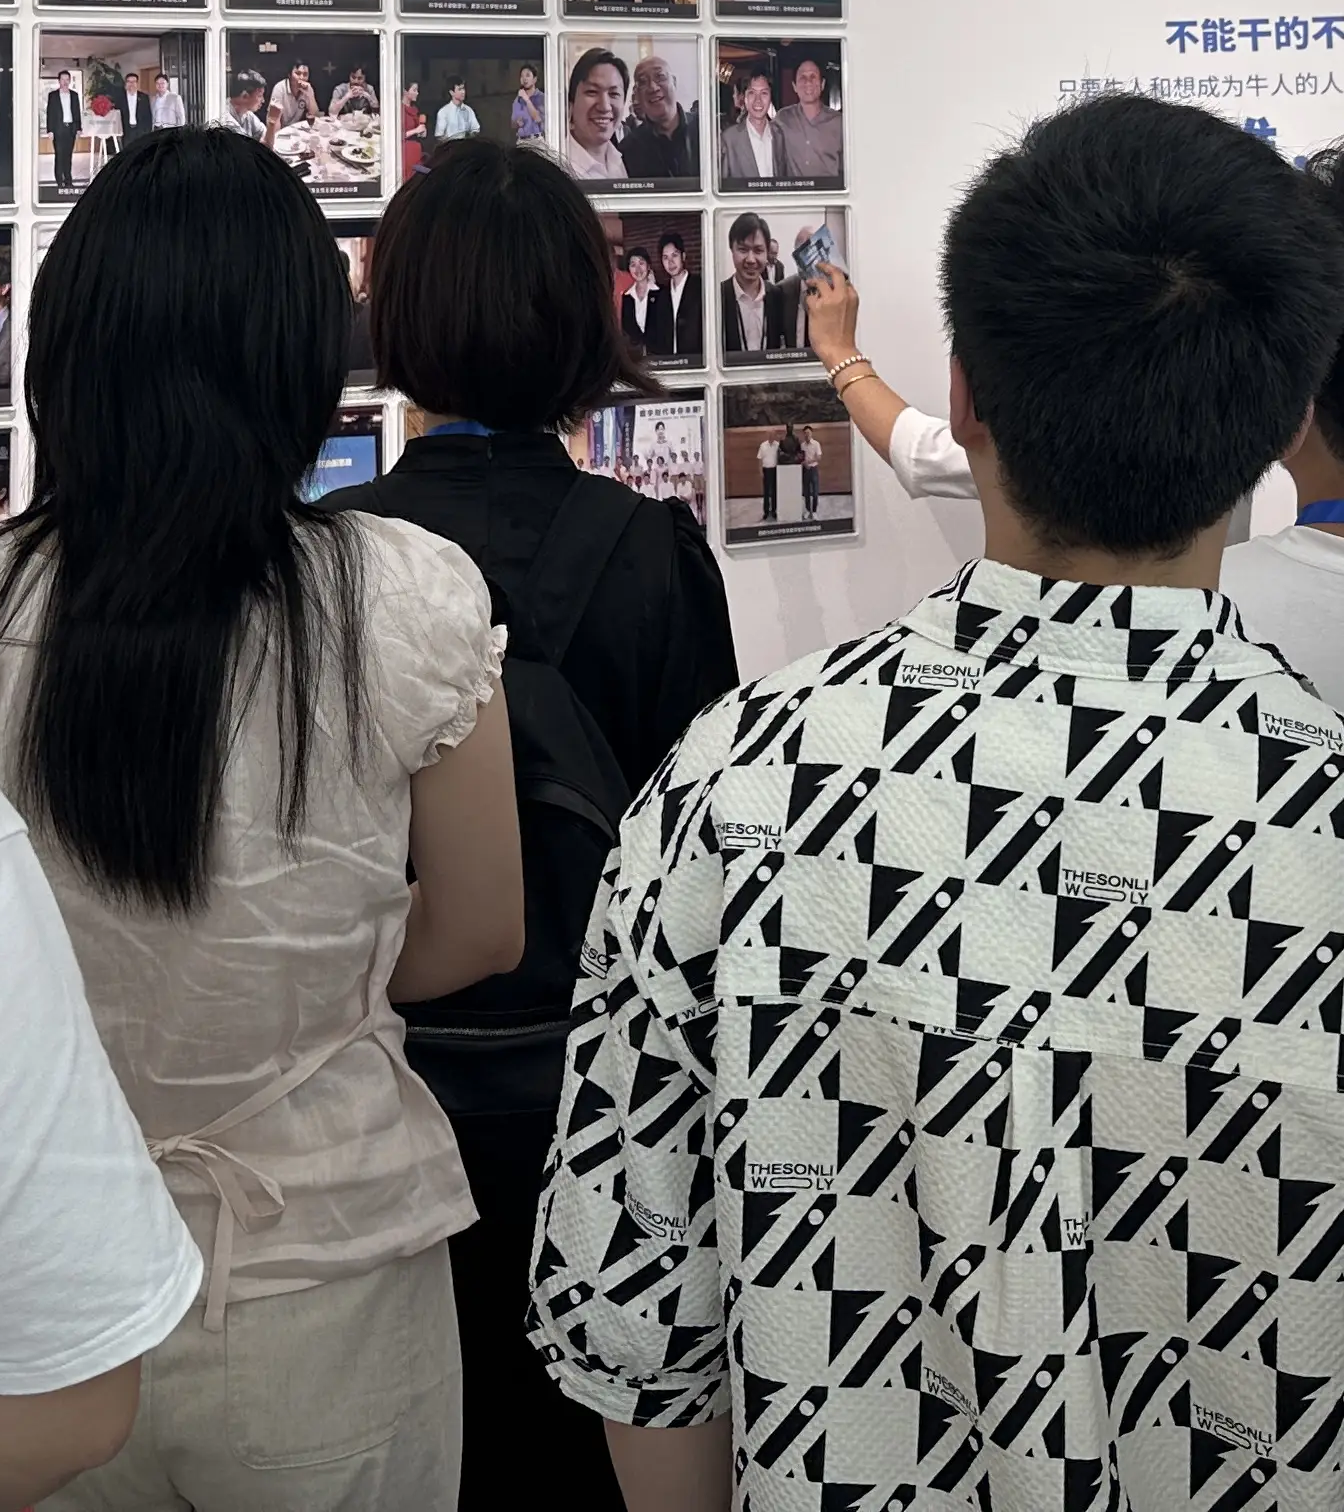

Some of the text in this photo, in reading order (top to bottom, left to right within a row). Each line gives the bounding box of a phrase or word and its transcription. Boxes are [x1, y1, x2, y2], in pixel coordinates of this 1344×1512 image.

[901, 663, 981, 678] THESONLI
[1260, 711, 1343, 742] THESONLI
[1061, 868, 1150, 891] THESONLI
[747, 1163, 834, 1177] THESONLI
[1193, 1402, 1273, 1445] THESONLI
